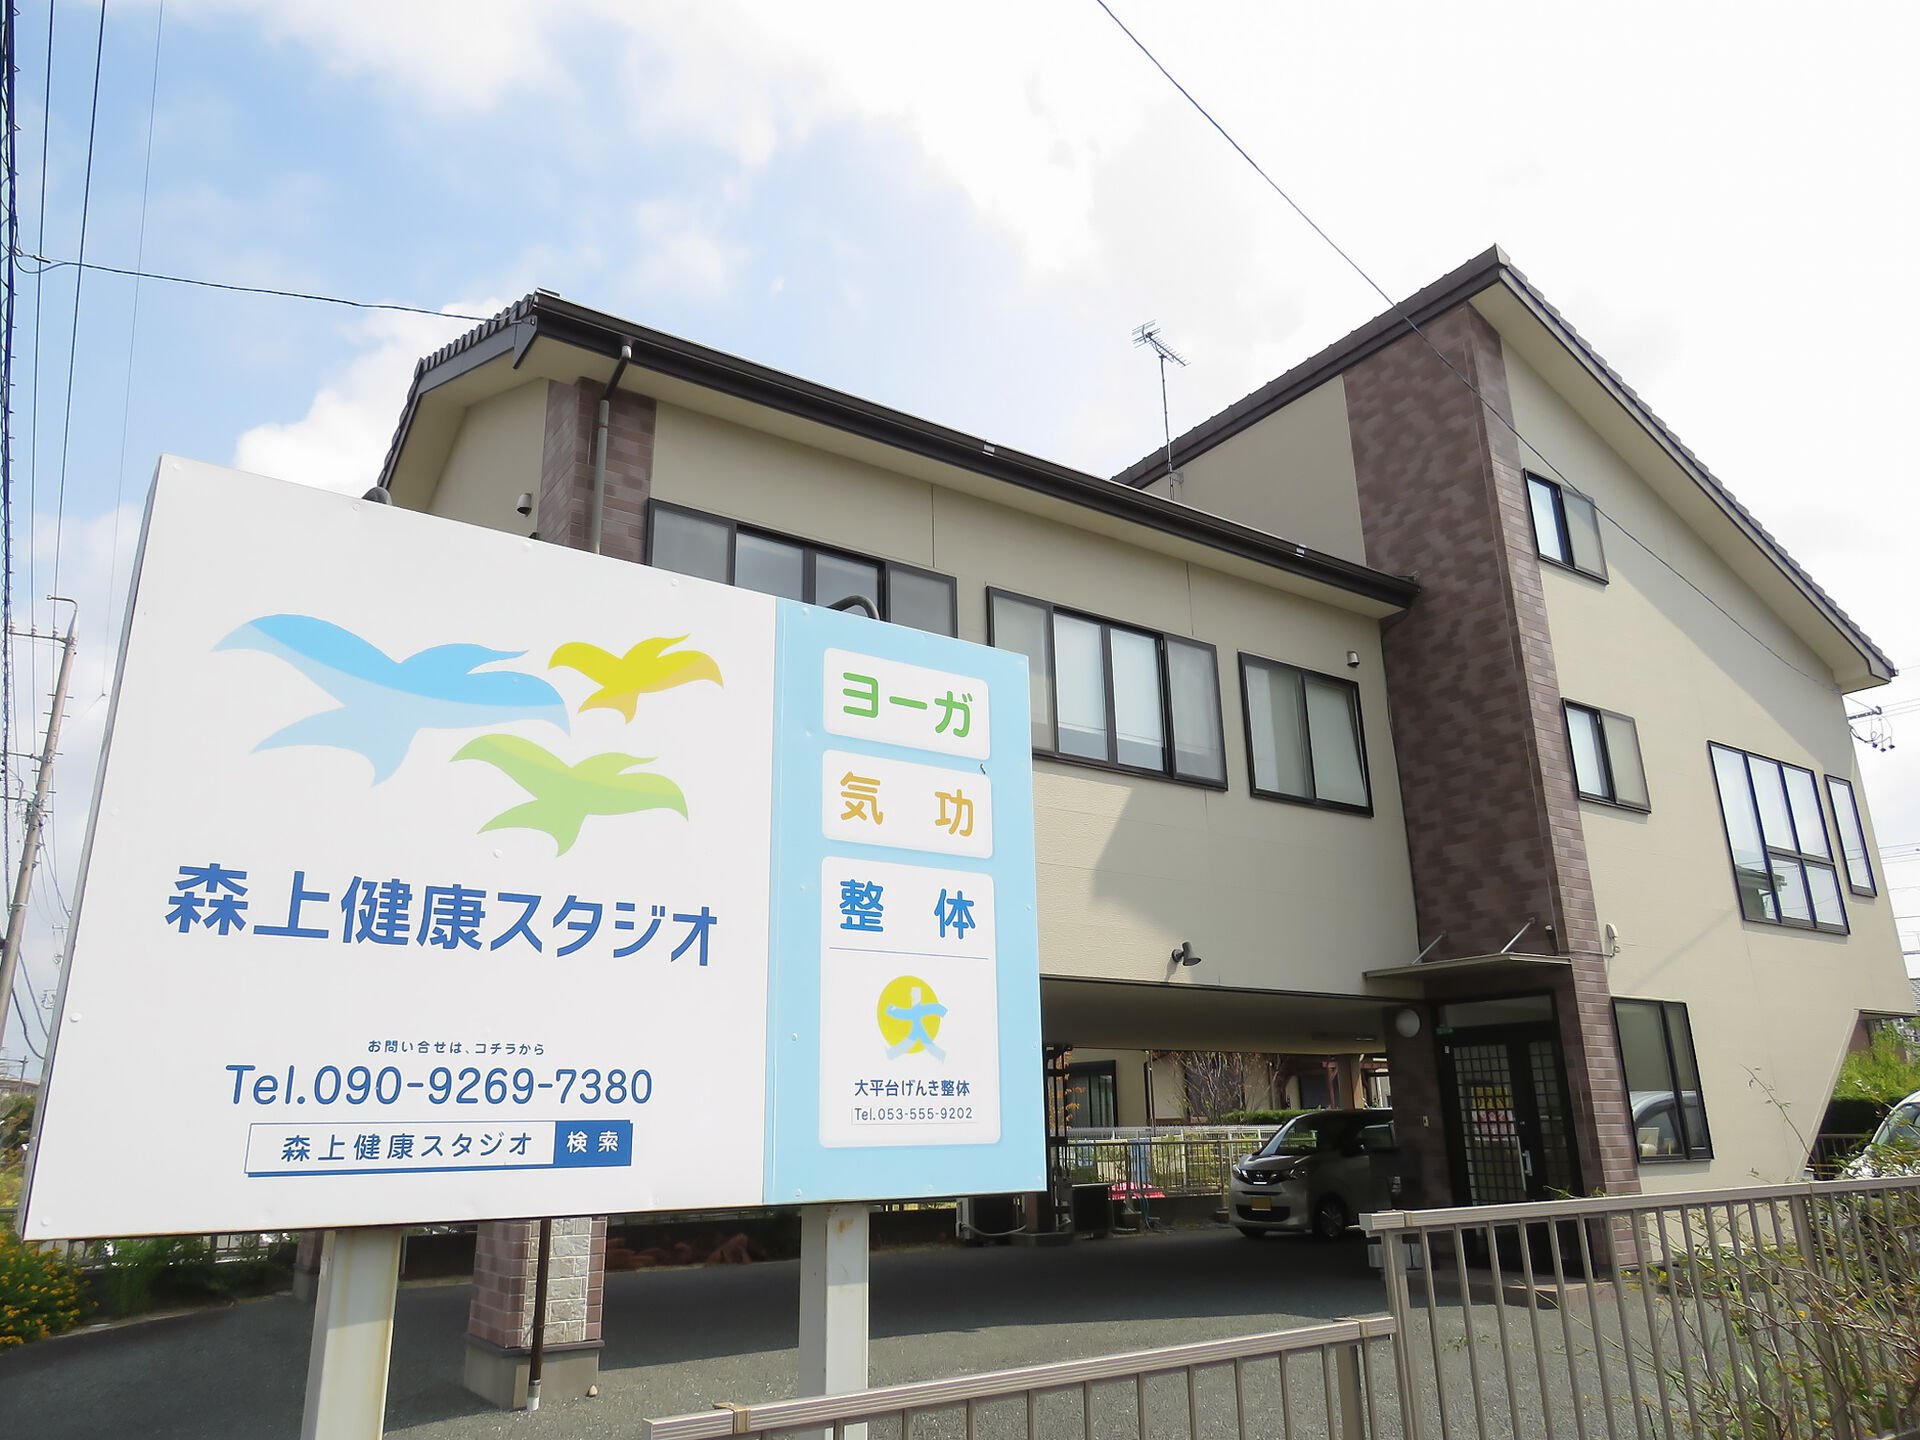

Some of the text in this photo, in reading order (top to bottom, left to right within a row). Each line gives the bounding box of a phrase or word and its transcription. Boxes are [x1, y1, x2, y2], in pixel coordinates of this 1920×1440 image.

[843, 672, 973, 737] ヨーガ
[840, 772, 974, 836] 気功
[165, 863, 718, 966] 森上健康スタジオ
[839, 879, 975, 939] 整体
[368, 1040, 545, 1056] お問い合せは、コチラから
[225, 1065, 653, 1105] Tel.090-9269-7380
[854, 1079, 970, 1097] 大平台げんき整体
[854, 1107, 973, 1121] Tel.053-555-9202
[281, 1132, 533, 1162] 森上健康スタジオ
[567, 1130, 619, 1153] 検索
